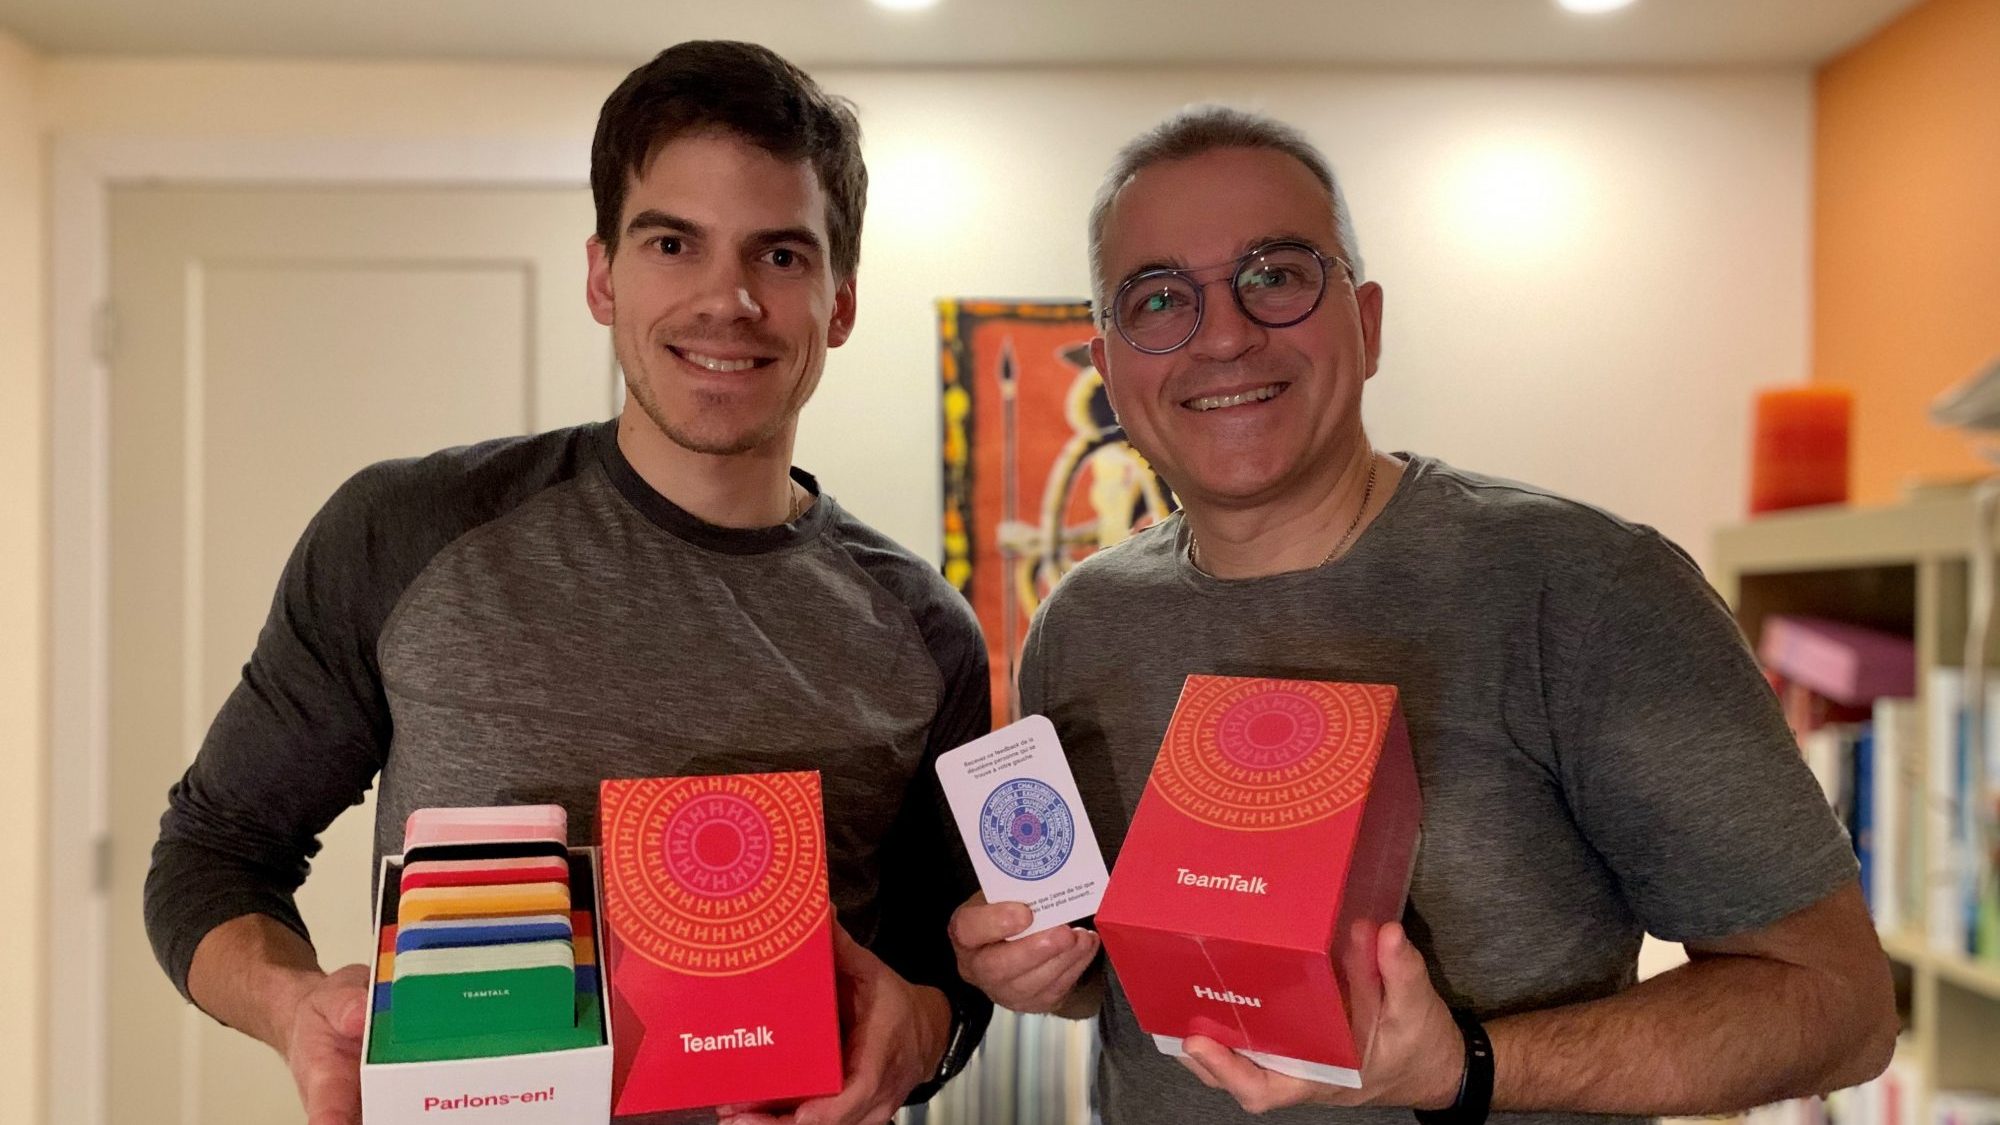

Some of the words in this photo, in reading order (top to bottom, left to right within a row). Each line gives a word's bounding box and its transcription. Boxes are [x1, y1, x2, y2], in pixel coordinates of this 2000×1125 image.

[994, 751, 1019, 765] personne
[995, 742, 1019, 755] feedback
[1177, 868, 1268, 894] TeamTalk
[463, 989, 510, 998] TEAMTALK
[1193, 985, 1262, 1008] Hubu
[680, 1026, 775, 1053] TeamTalk
[424, 1087, 555, 1112] Parlons-en!
